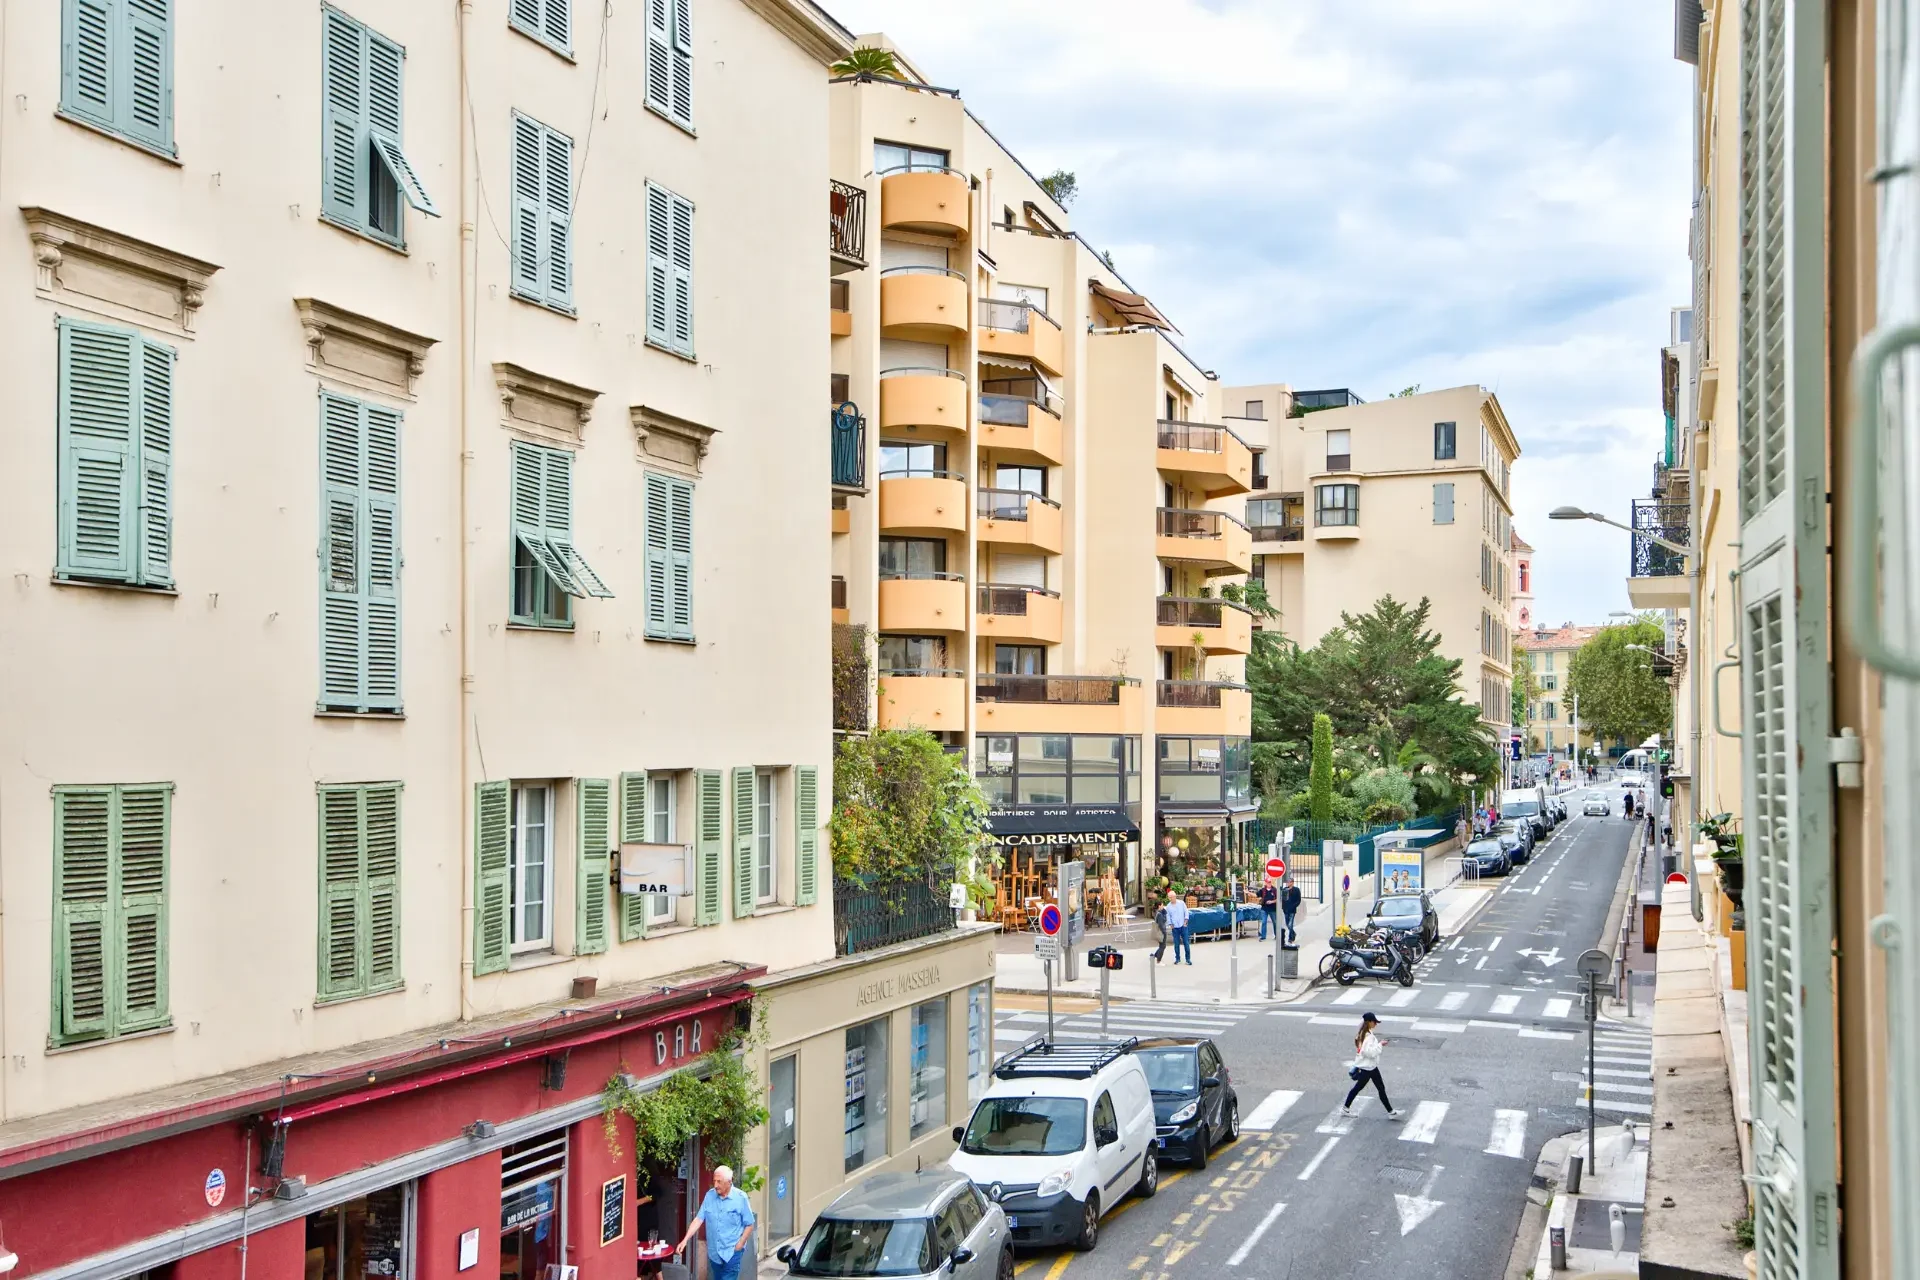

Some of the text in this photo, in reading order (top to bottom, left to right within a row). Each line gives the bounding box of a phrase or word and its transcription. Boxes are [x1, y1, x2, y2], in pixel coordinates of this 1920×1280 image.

[991, 831, 1129, 846] NCADREMENTS
[640, 884, 668, 892] BAR
[857, 964, 941, 1007] AGENCE MASSENA
[655, 1019, 702, 1066] BAR
